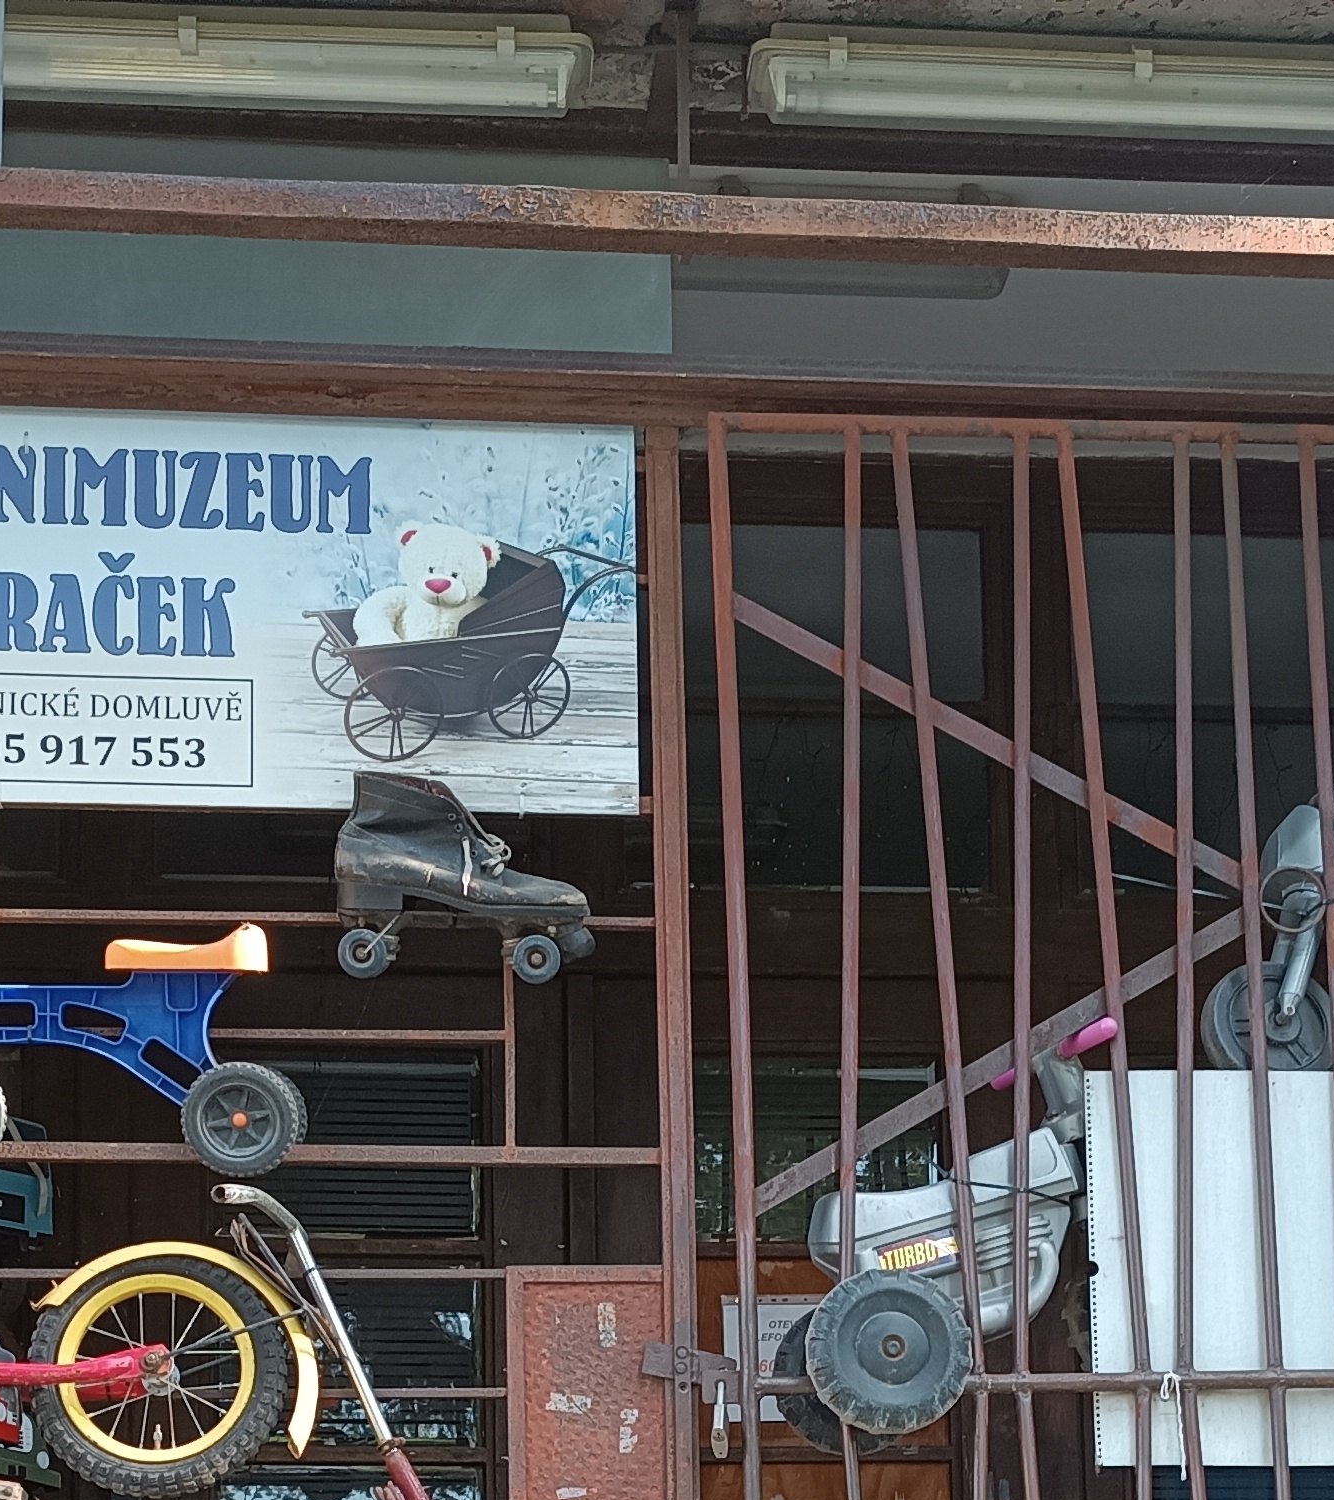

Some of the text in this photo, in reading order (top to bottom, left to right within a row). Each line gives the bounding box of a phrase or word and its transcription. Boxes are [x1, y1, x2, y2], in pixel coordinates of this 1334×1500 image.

[90, 691, 243, 722] DOMLUVĚ
[40, 733, 117, 766] 917
[131, 735, 207, 768] 553
[883, 1242, 938, 1271] TURBO
